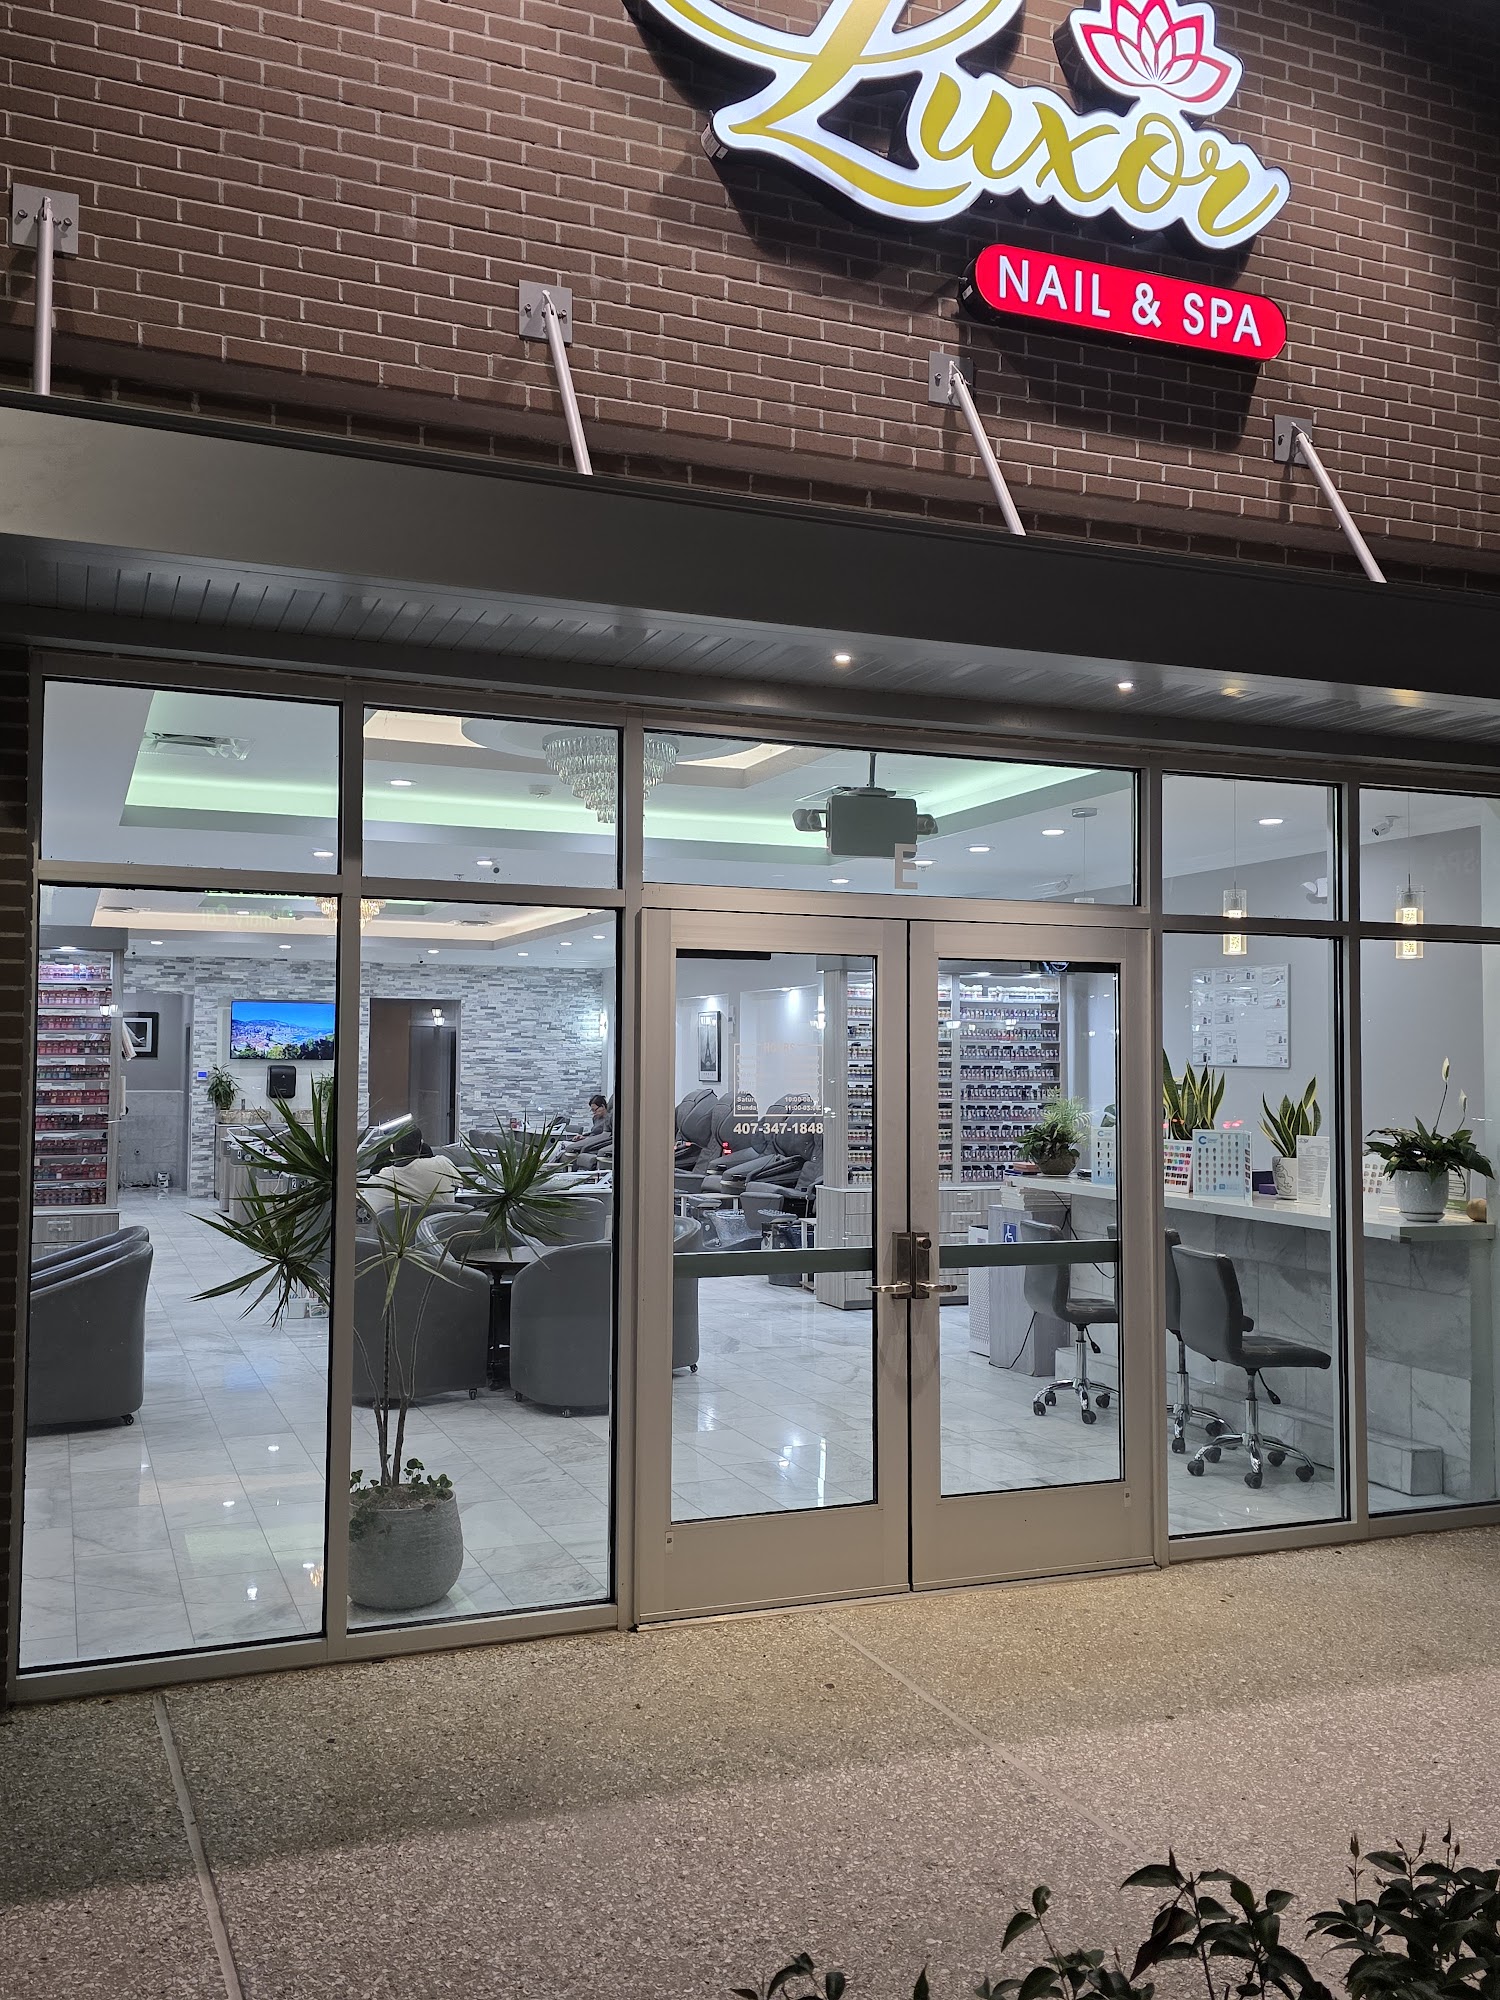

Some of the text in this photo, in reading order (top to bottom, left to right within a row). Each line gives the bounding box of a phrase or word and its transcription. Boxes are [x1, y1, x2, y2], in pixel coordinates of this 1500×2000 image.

[658, 0, 1280, 238] Luxor
[998, 254, 1263, 347] NAIL & SPA
[894, 842, 919, 890] E
[763, 1041, 796, 1055] HORS
[733, 1122, 824, 1135] 407-347-1848
